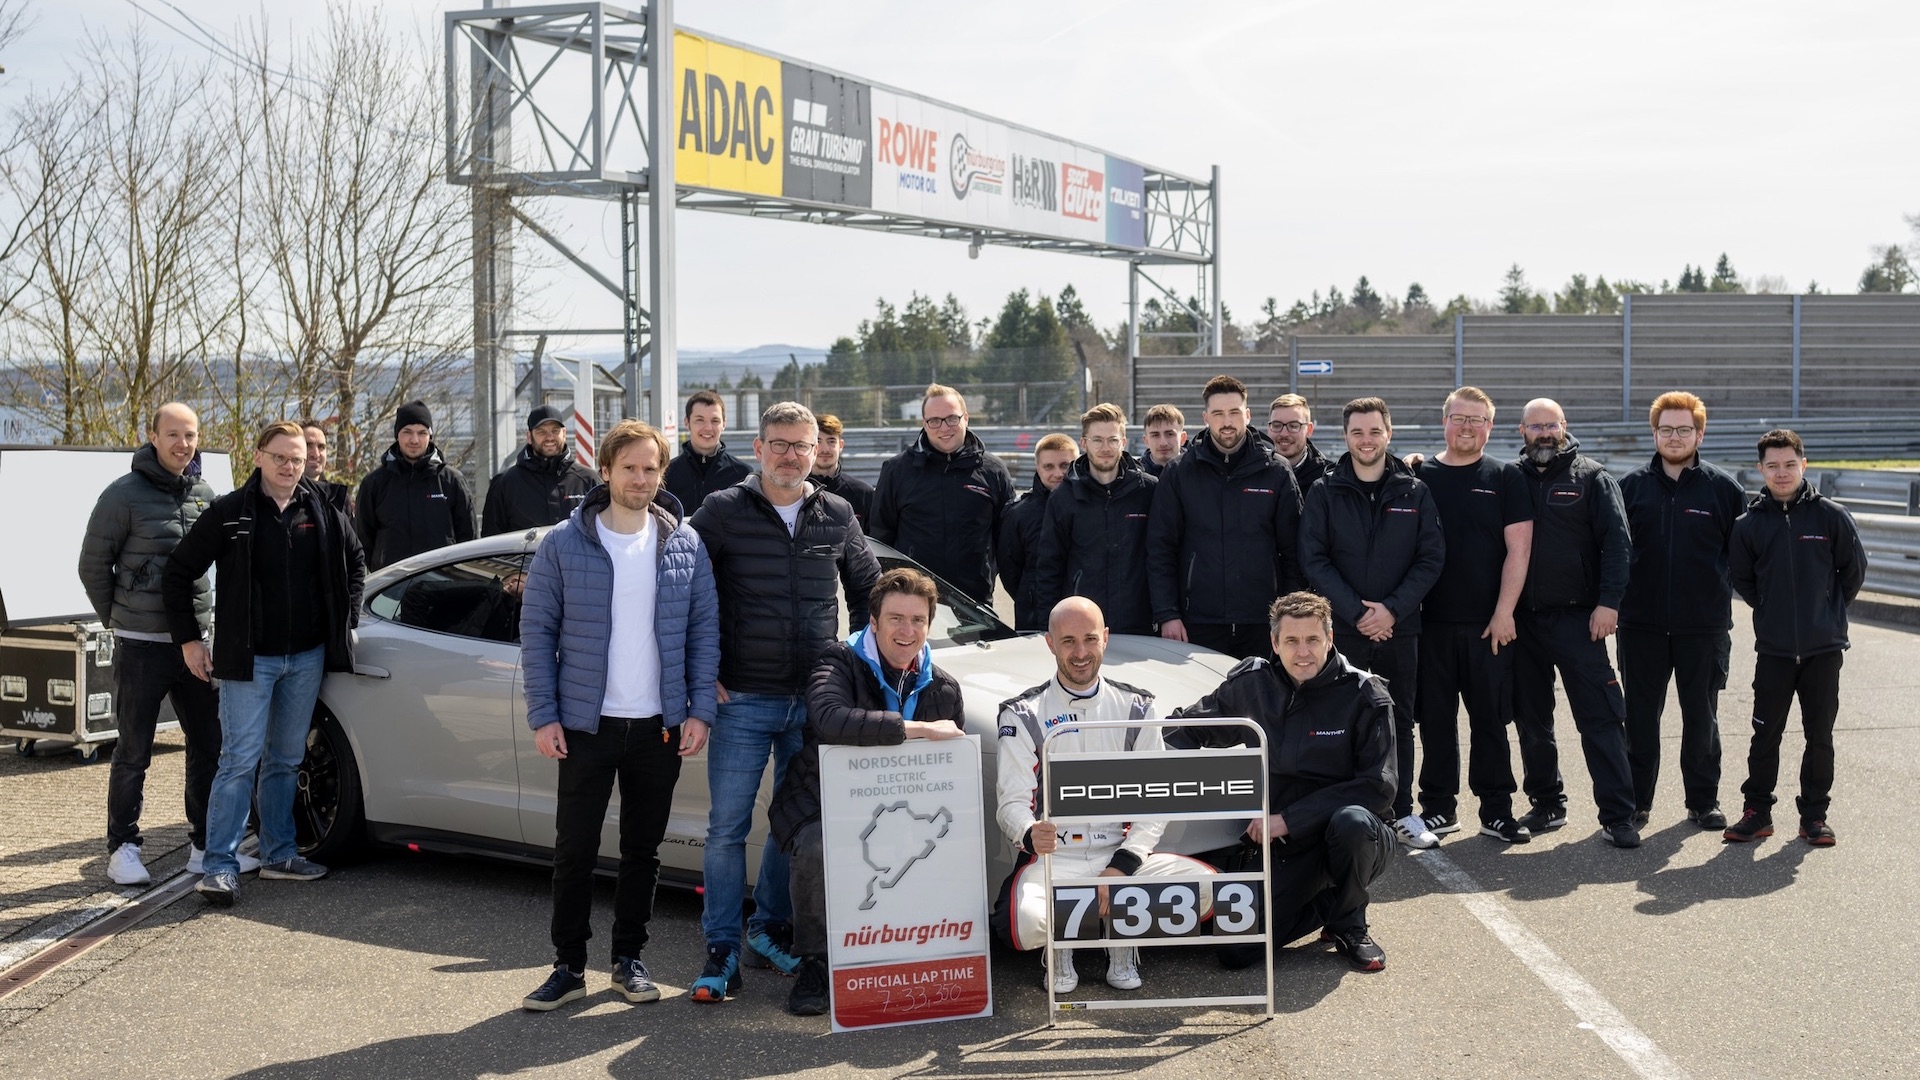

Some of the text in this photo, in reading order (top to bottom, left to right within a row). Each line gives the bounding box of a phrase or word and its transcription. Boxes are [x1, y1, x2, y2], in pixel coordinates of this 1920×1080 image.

[678, 68, 774, 165] ADAC
[790, 125, 863, 165] GRAN TURISMO
[878, 117, 937, 173] ROWE
[789, 154, 800, 166] THE
[800, 156, 813, 168] REAL
[813, 159, 833, 172] DRIVING
[899, 172, 937, 194] MOTOR OIL
[1012, 153, 1042, 208] H&R
[1067, 168, 1089, 187] sport
[1064, 185, 1102, 218] auto
[1044, 713, 1069, 729] Mobil
[848, 752, 953, 771] NORDSCHLEIFE
[877, 771, 927, 784] ELECTRIC
[850, 781, 954, 798] PRODUCTION CARS
[1059, 779, 1254, 800] PORSCHE
[1055, 887, 1096, 939] 7
[1216, 883, 1256, 933] 3
[843, 918, 973, 947] nürburgring
[846, 967, 974, 991] OFFICIAL LAP TIME
